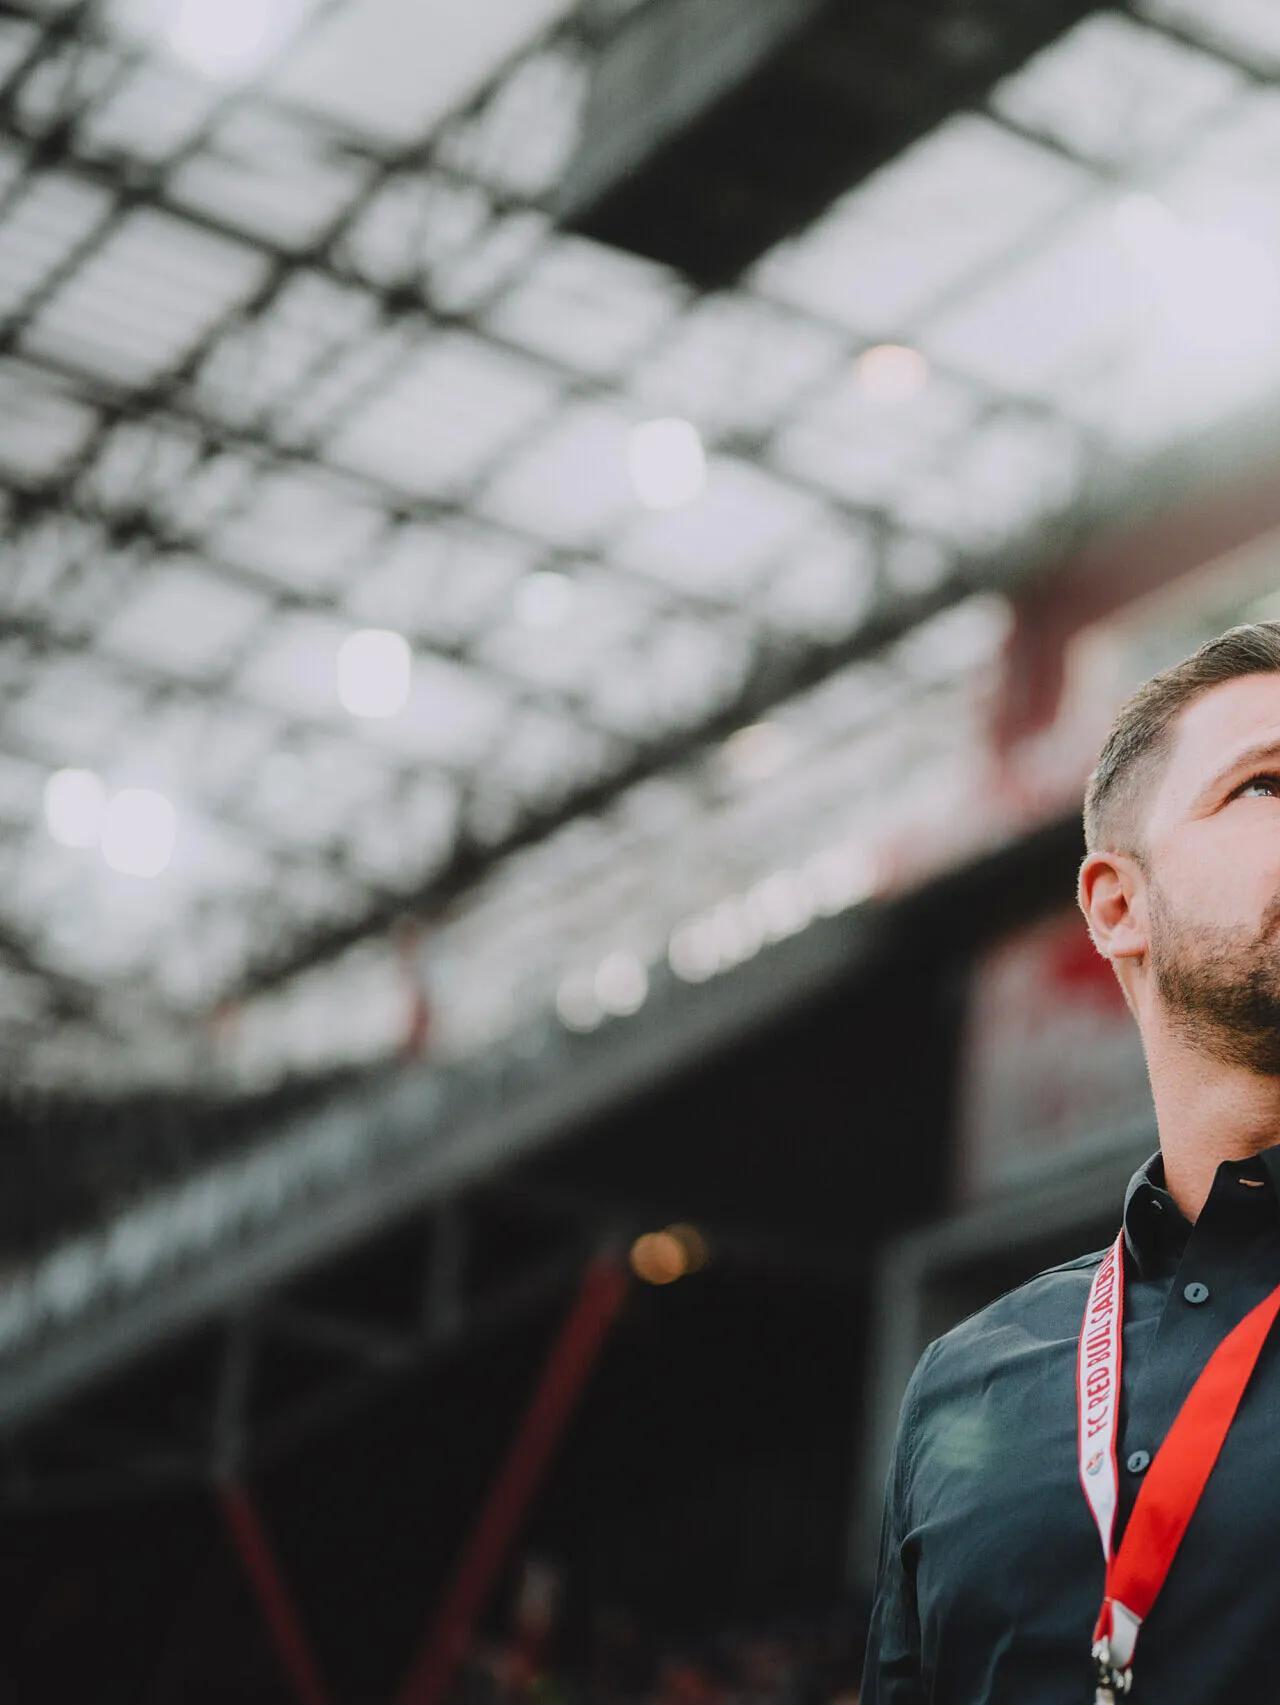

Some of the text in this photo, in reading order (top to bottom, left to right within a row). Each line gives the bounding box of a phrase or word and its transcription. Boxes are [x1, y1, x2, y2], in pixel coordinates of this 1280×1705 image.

[1087, 1247, 1115, 1438] FC RED BULL SALZBU
